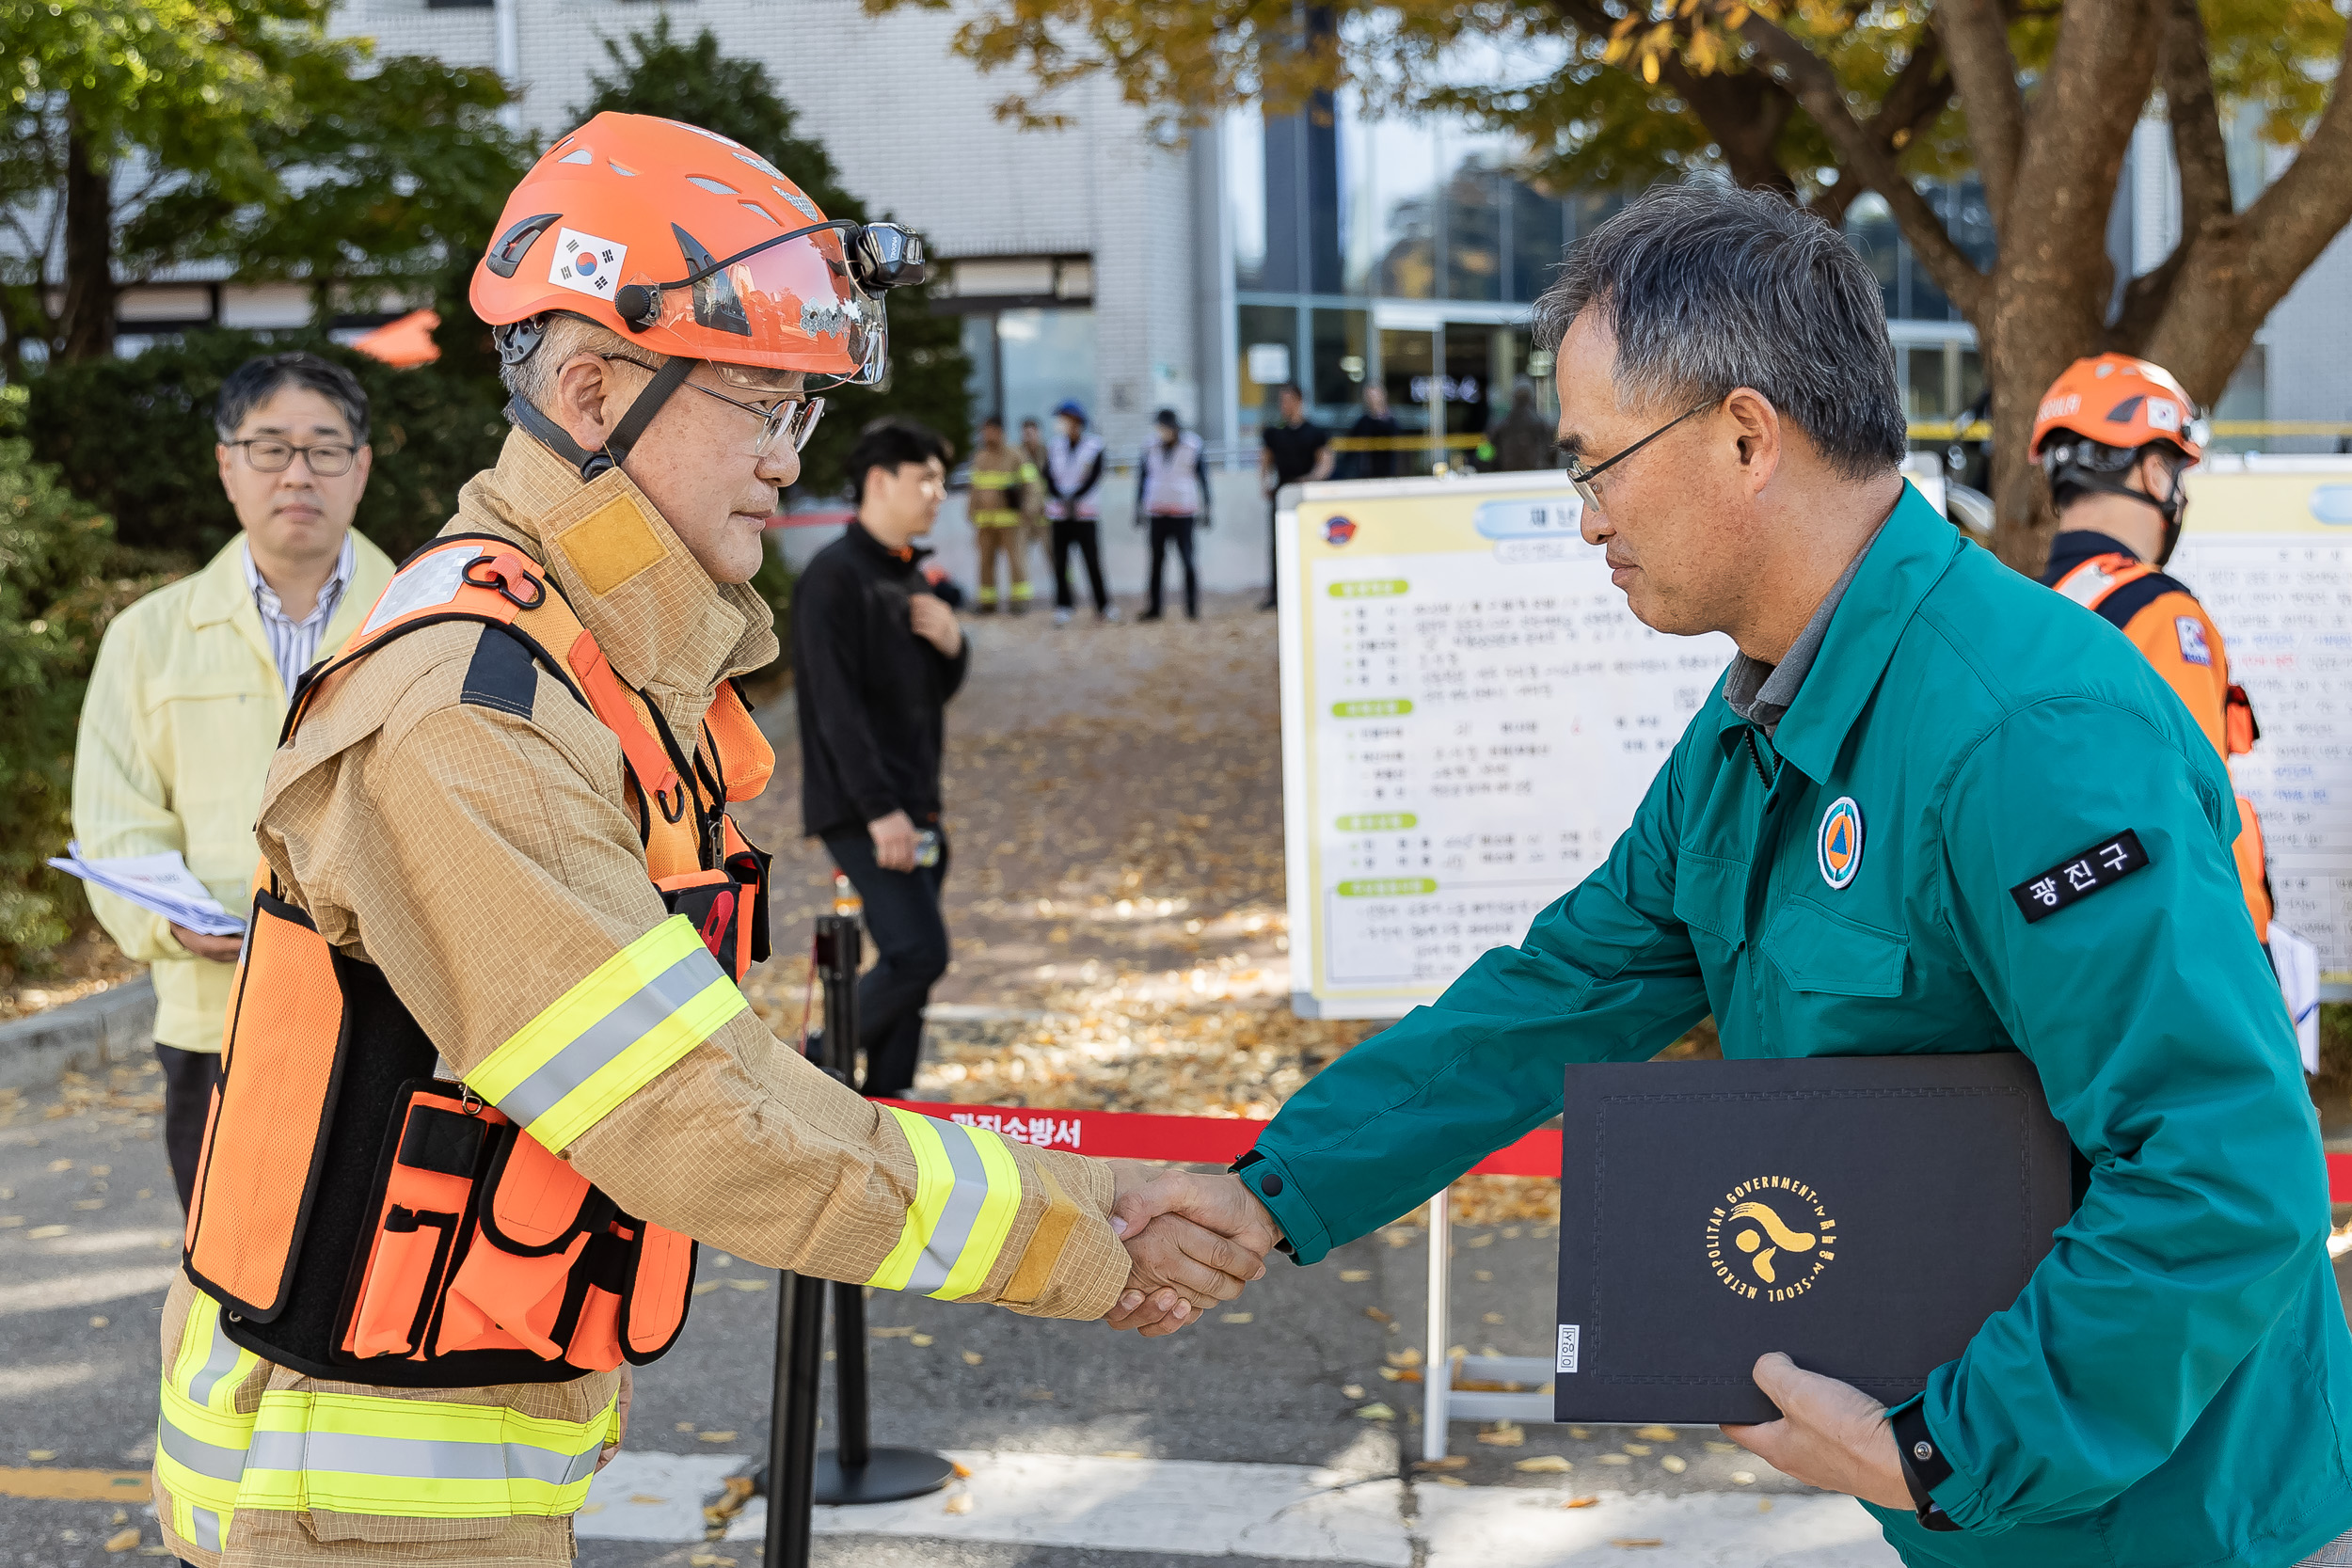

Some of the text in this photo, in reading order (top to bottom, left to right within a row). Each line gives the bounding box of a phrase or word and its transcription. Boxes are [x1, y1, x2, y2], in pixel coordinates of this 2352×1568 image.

[2029, 843, 2128, 906] 광진구
[1706, 1175, 1818, 1303] SEOUL METROPOLITAN GOVERNMENT
[1561, 1331, 1576, 1366] 이양서
